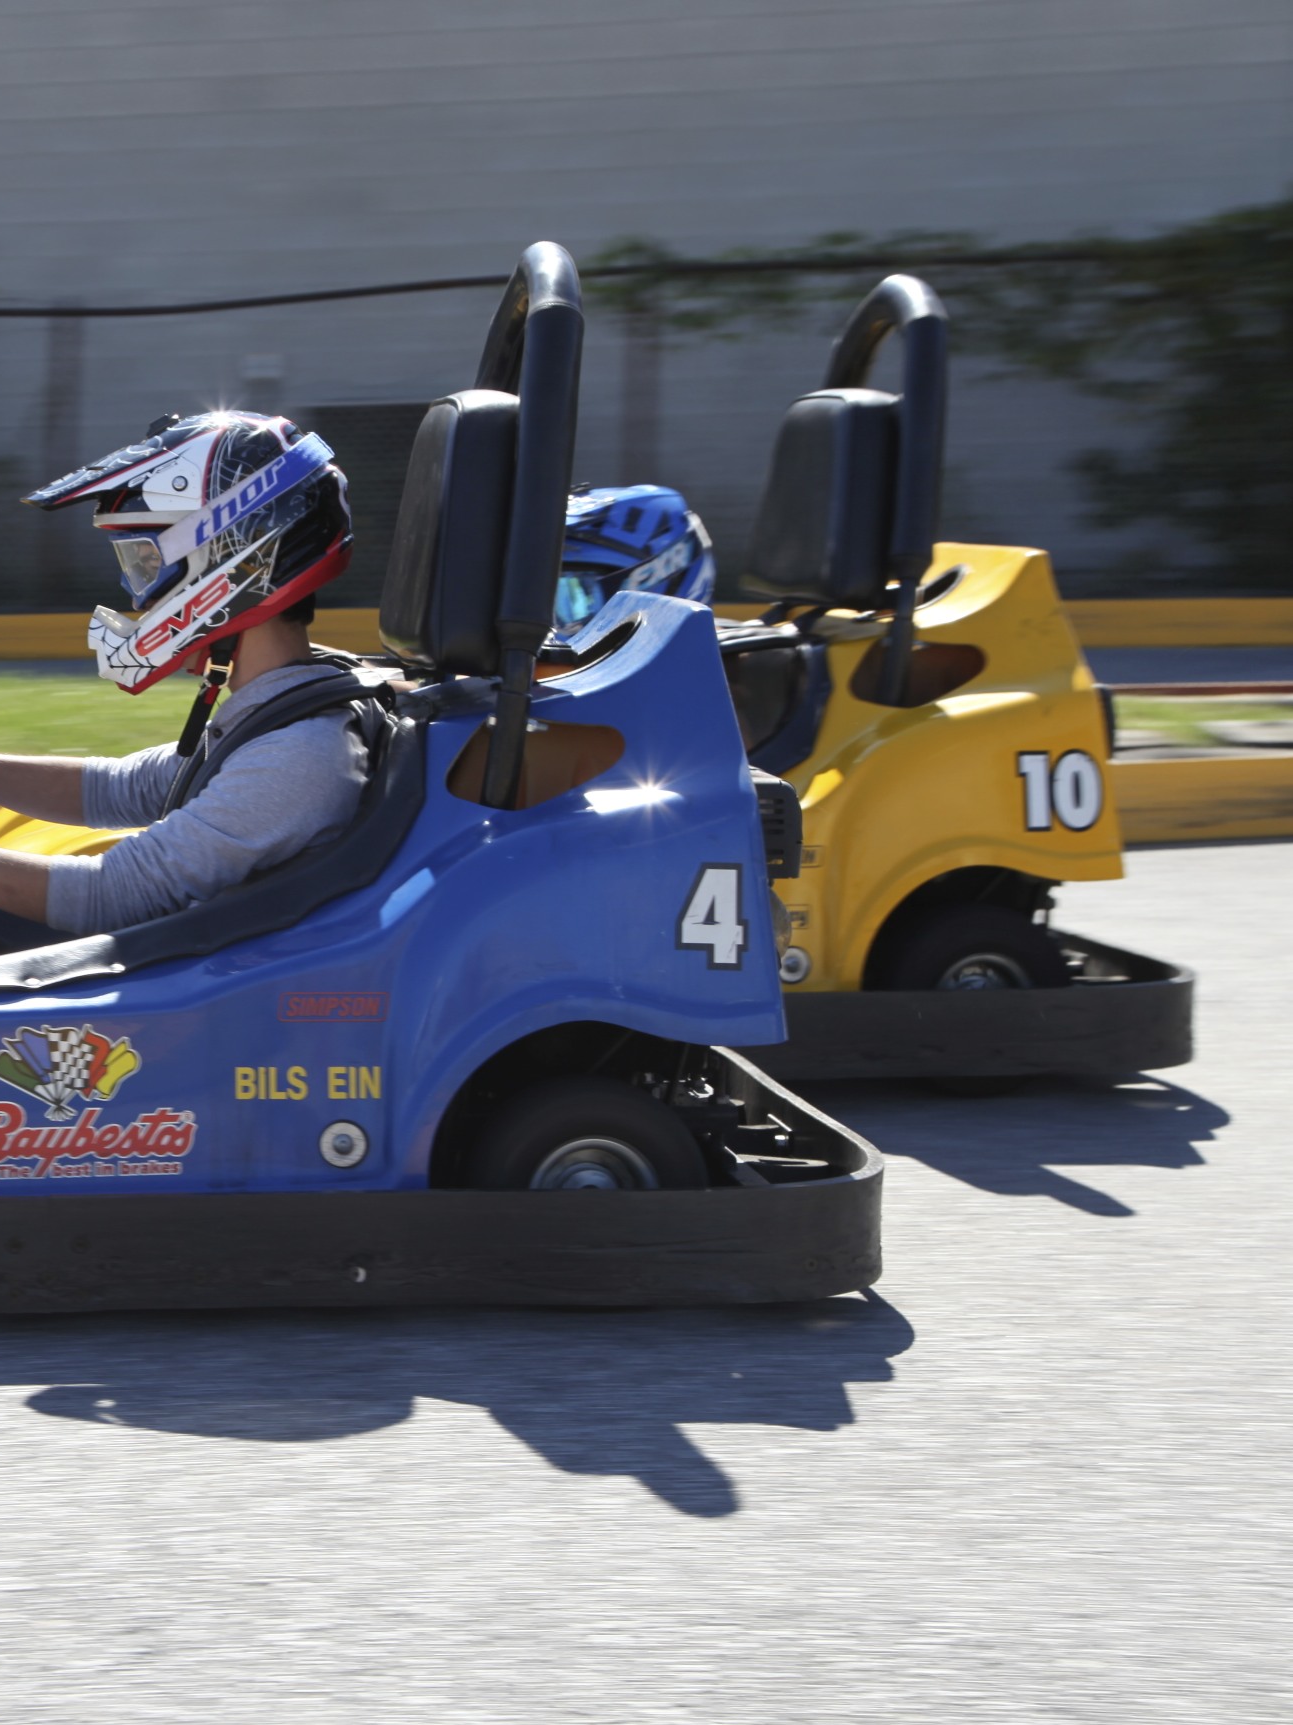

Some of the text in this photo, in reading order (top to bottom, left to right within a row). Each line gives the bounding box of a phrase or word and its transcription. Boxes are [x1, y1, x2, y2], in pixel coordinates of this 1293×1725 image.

[195, 455, 286, 547] thor
[1016, 749, 1105, 831] 10
[677, 864, 747, 969] 4
[286, 996, 382, 1017] SIMPSON
[234, 1065, 382, 1100] BILS EIN
[50, 1163, 91, 1177] best
[94, 1162, 115, 1176] in
[118, 1160, 182, 1175] brakes
